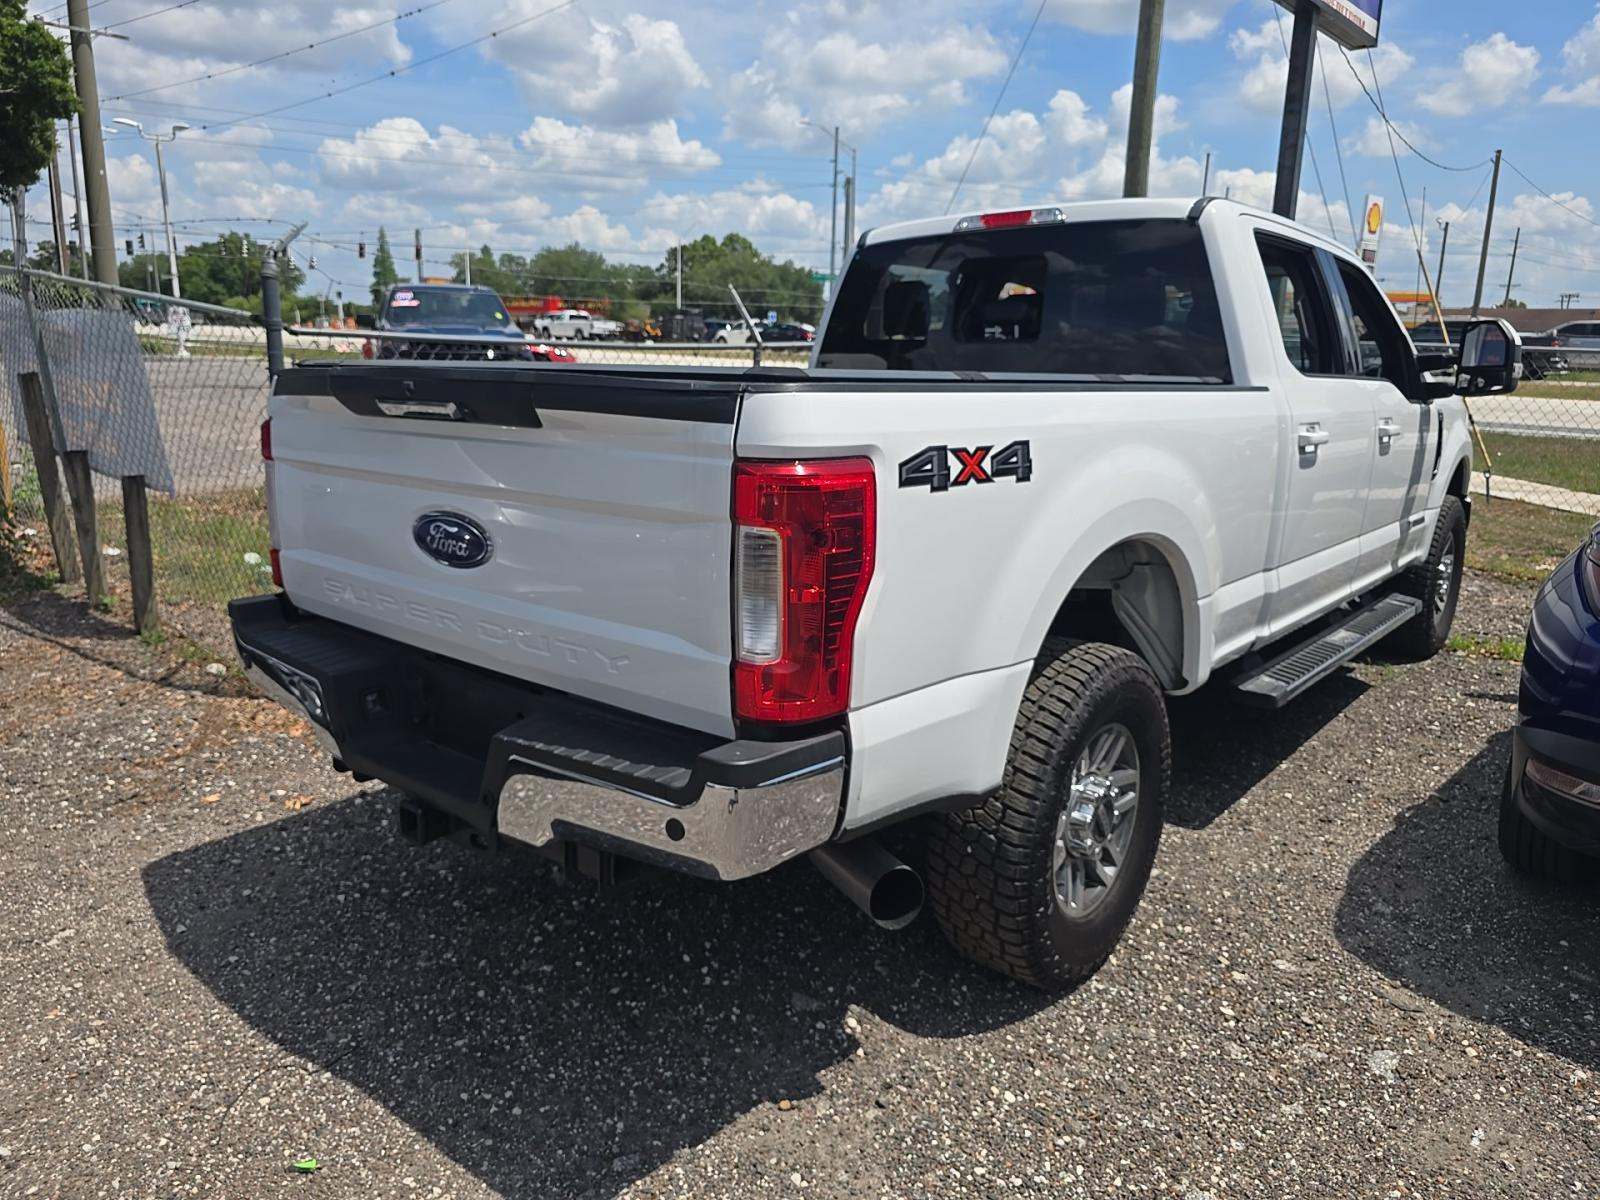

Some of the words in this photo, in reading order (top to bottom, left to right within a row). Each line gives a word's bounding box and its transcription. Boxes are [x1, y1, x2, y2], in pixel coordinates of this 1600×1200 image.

[426, 521, 470, 558] Ford
[322, 578, 463, 632] SUPER
[475, 618, 631, 675] DUTY
